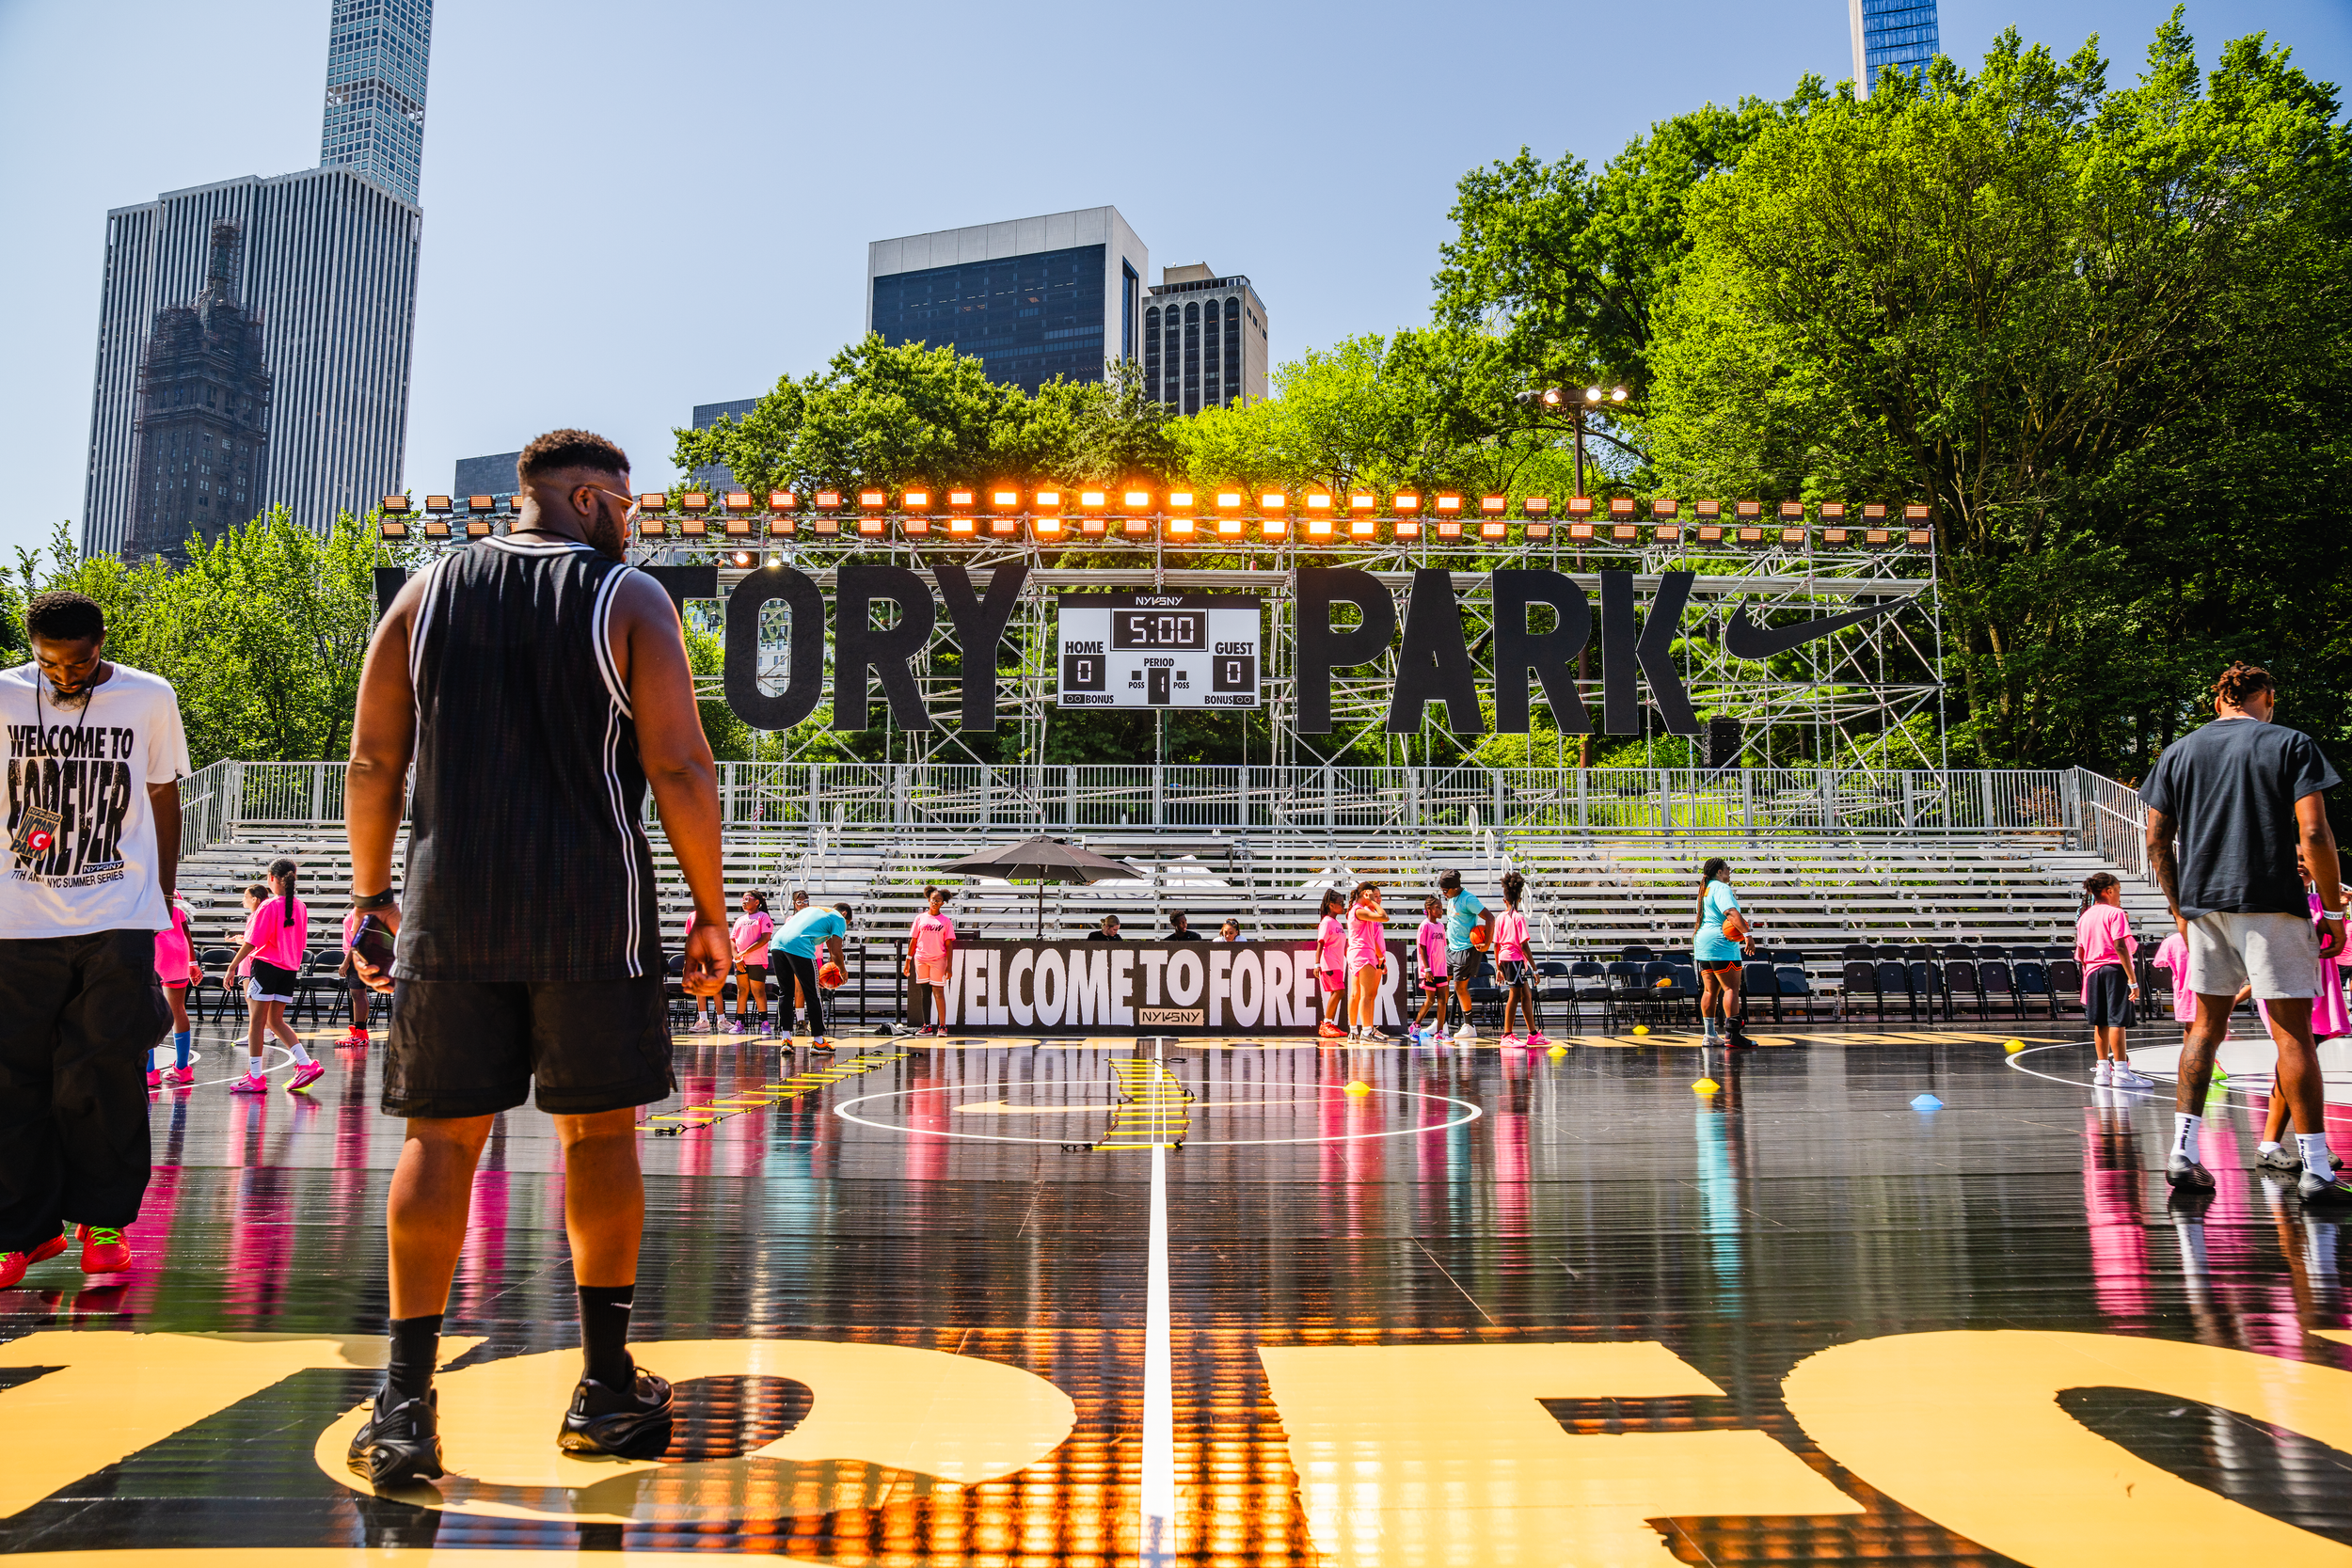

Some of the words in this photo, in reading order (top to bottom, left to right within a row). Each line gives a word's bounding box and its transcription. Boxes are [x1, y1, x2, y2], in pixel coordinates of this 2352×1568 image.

[1130, 616, 1194, 643] 5:00
[1065, 641, 1104, 655] HOME
[1215, 641, 1254, 655] GUEST
[1296, 568, 1702, 736] PARK
[1144, 658, 1174, 667] PERIOD
[1077, 660, 1091, 682] 0
[1226, 661, 1241, 684] 0
[1128, 681, 1145, 689] POSS
[1173, 681, 1190, 689] POSS
[1085, 694, 1114, 705] BONUS
[1204, 695, 1233, 705] BONUS
[7, 724, 106, 759] WELCOME
[110, 727, 134, 759] TO
[11, 870, 26, 880] 7TH
[63, 875, 96, 888] SUMMER
[97, 870, 124, 884] SERIES
[1139, 949, 1204, 1007] TO
